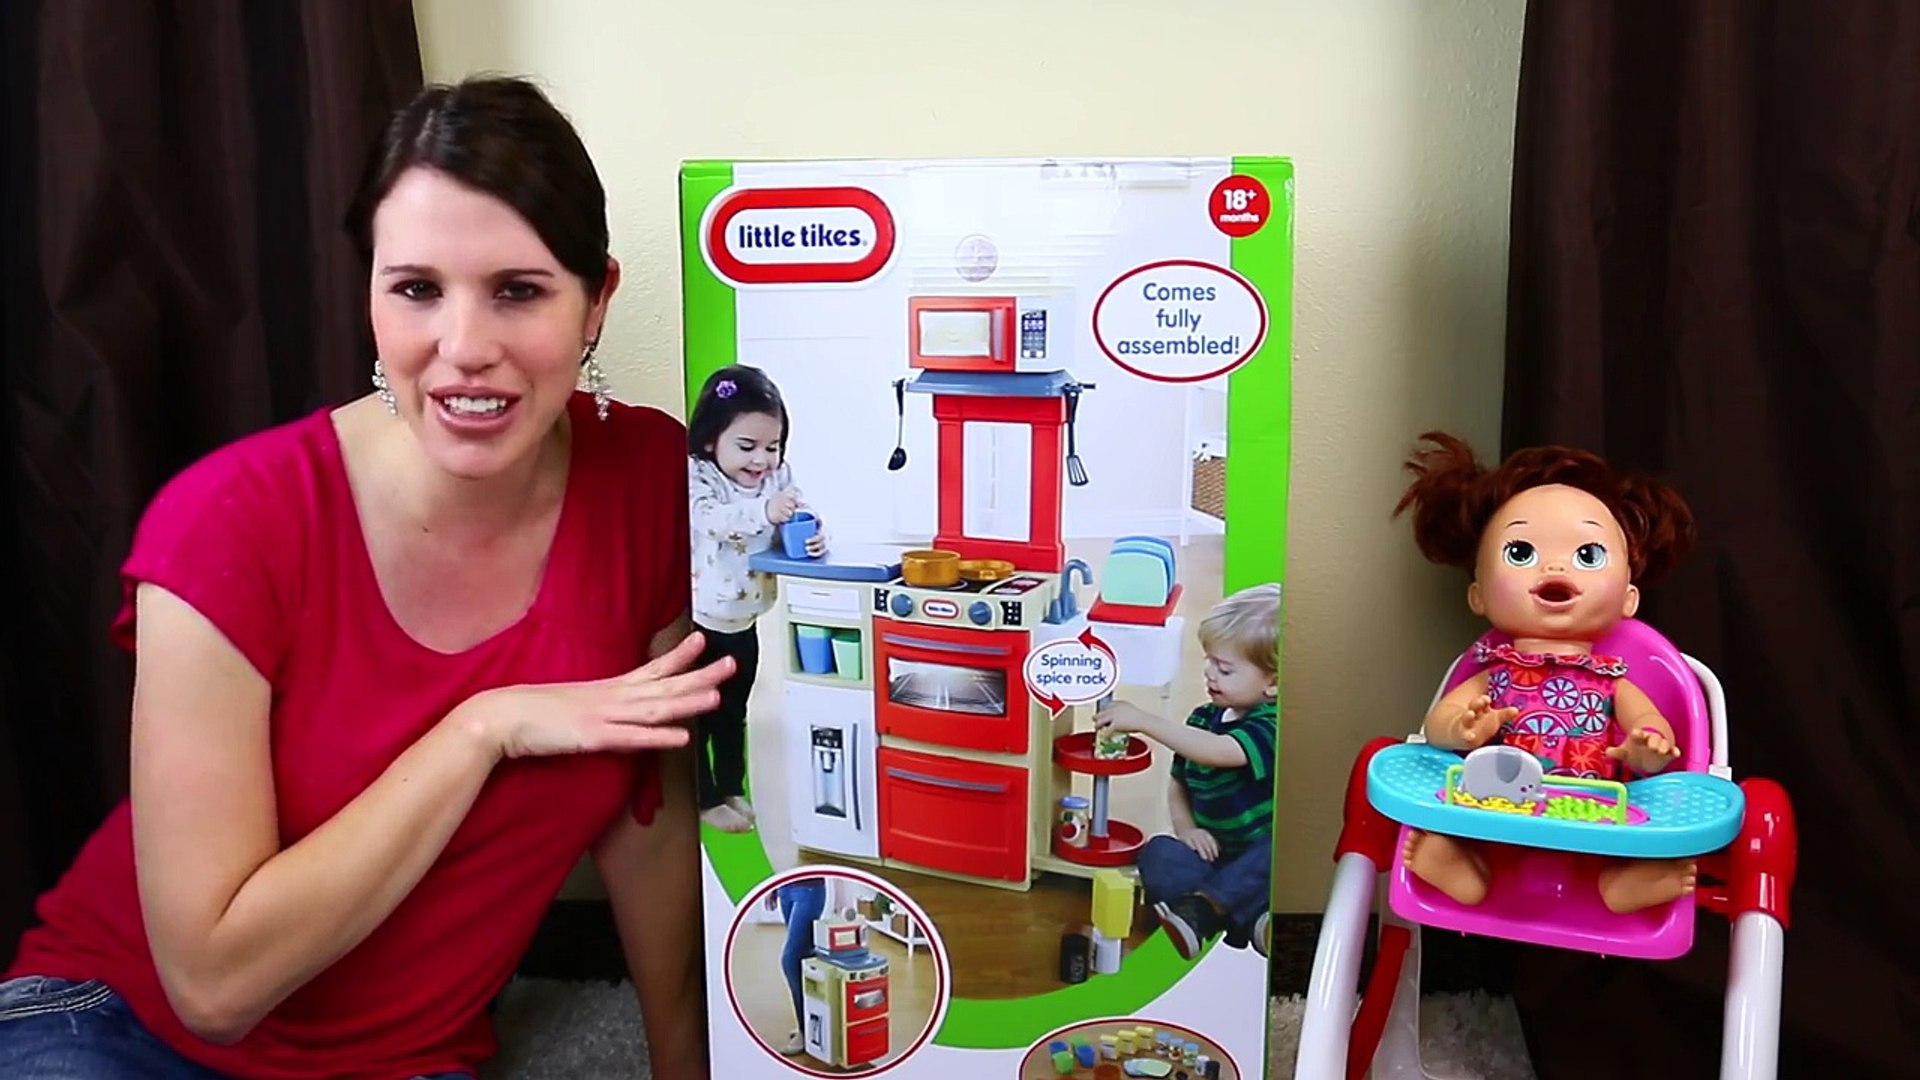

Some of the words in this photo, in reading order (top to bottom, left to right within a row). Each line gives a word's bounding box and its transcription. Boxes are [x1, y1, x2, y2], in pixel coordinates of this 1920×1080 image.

[1222, 189, 1257, 211] 18+
[1219, 212, 1259, 223] months
[739, 225, 796, 248] little
[1142, 282, 1216, 301] Comes
[1155, 308, 1202, 332] fully
[1117, 335, 1240, 355] assembled!
[1041, 653, 1102, 670] Spinning
[1036, 671, 1072, 686] spice
[1077, 672, 1107, 685] rack
